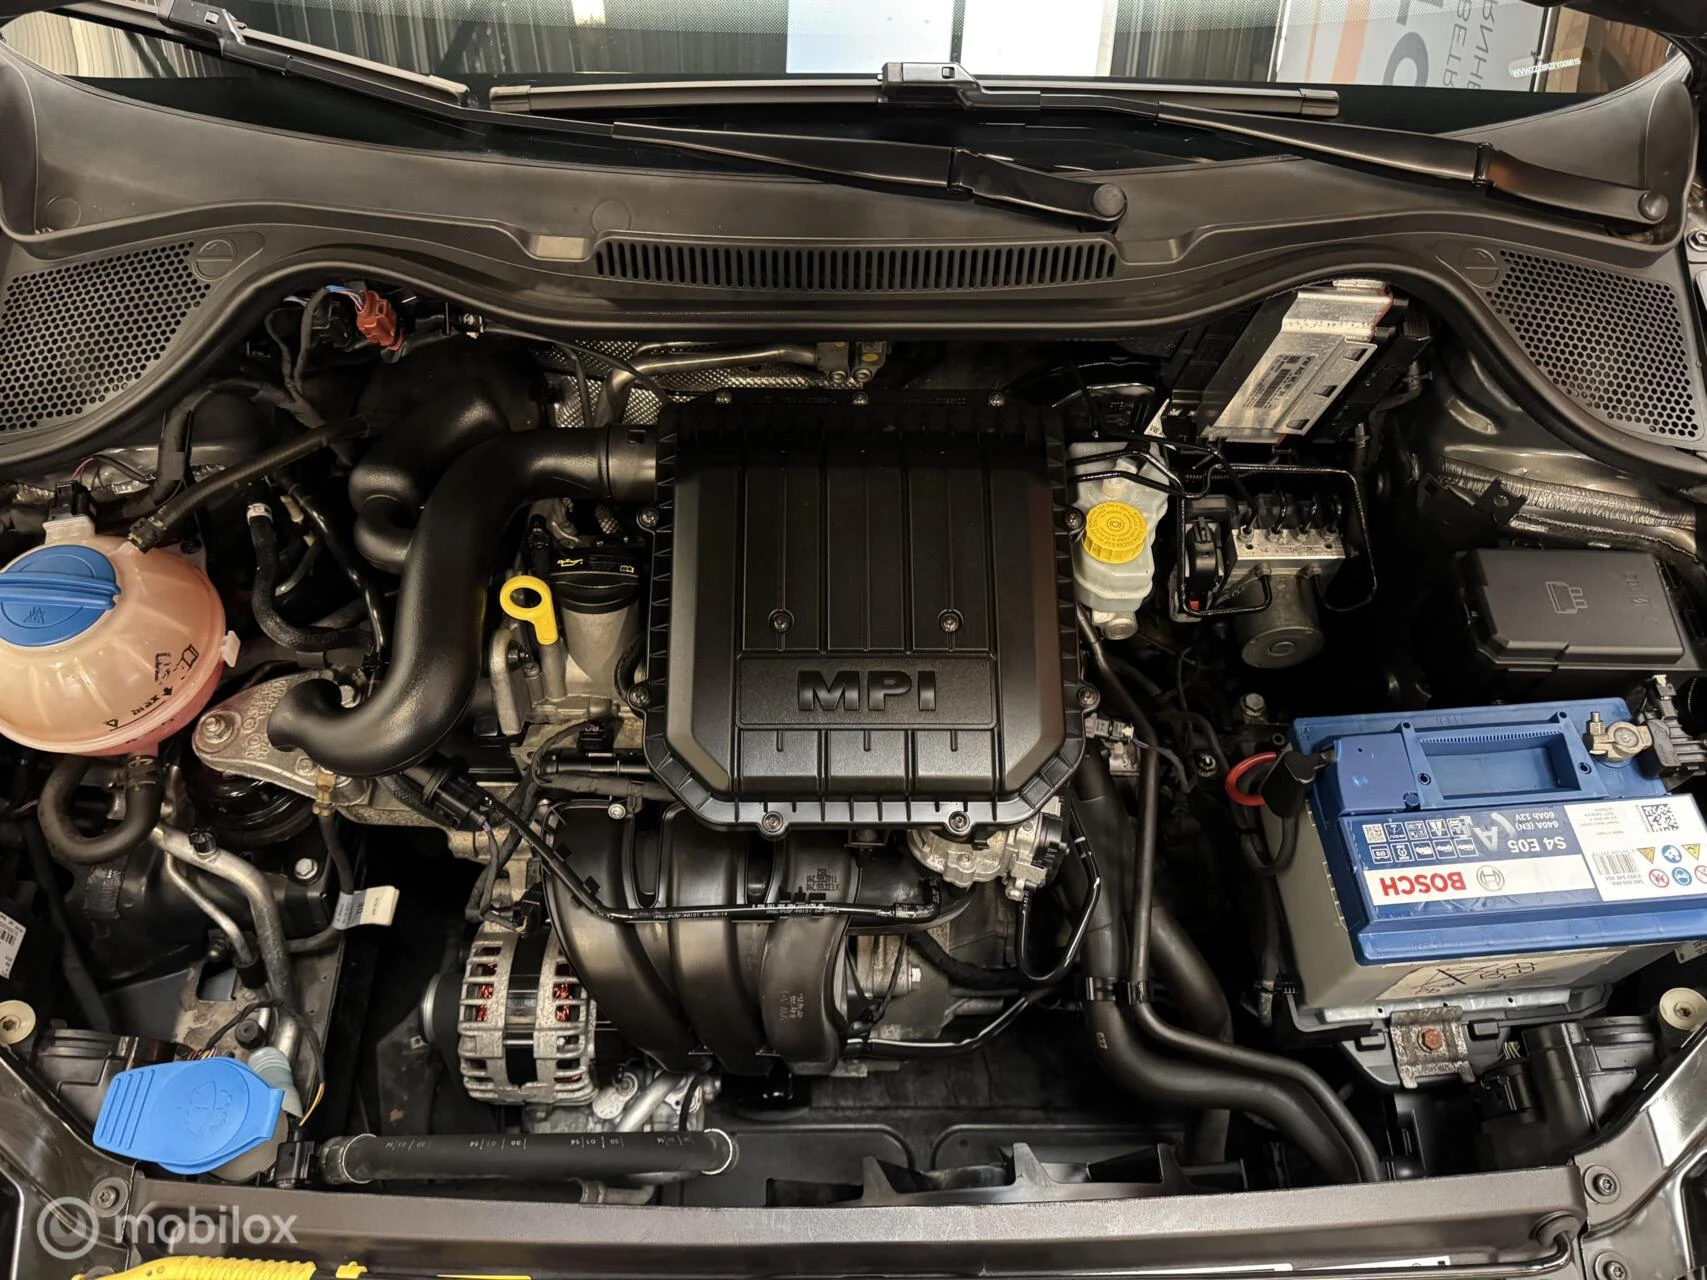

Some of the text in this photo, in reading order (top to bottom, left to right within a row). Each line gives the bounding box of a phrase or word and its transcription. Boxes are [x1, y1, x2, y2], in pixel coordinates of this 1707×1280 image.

[796, 669, 938, 714] MPI
[1515, 810, 1555, 822] 60Ah 12V
[1516, 820, 1559, 832] 640A (EN)
[1507, 836, 1567, 853] S4 E05
[1379, 871, 1467, 896] BOSCH
